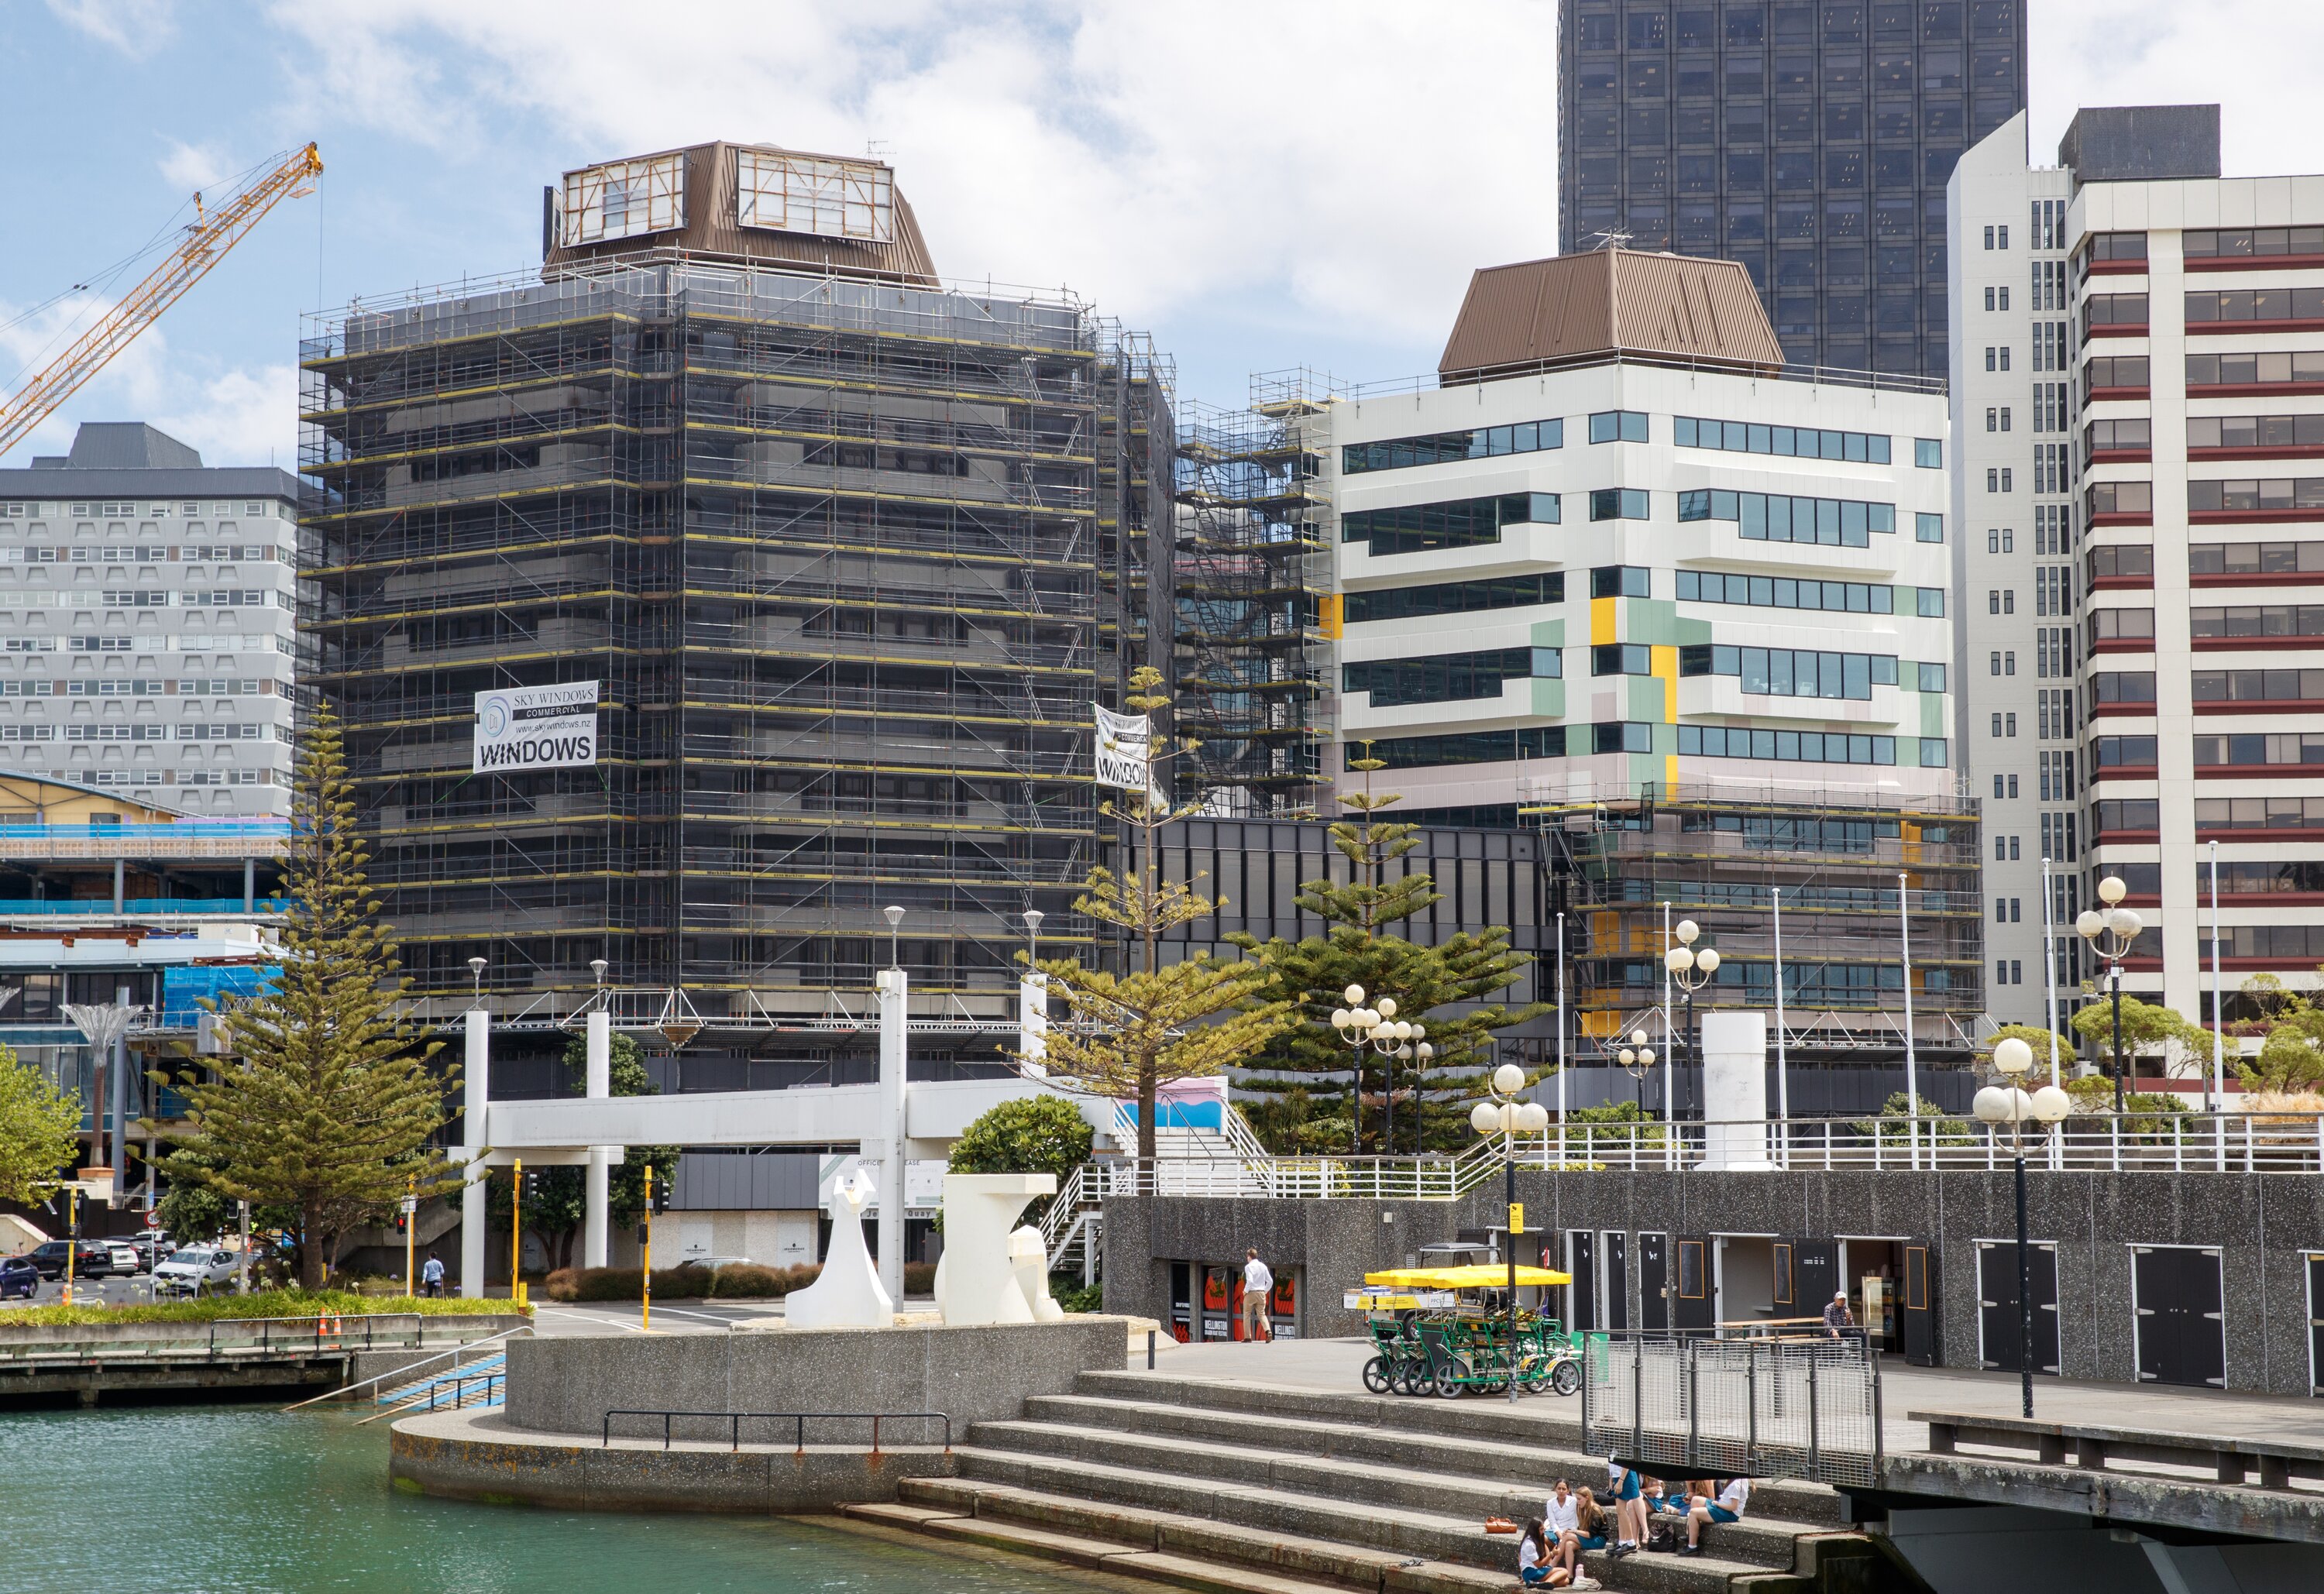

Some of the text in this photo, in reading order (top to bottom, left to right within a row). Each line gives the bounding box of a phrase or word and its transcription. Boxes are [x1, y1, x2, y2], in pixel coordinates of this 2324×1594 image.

[514, 689, 594, 706] SKY WINDOWS
[526, 706, 580, 718] COMMERCIAL
[480, 737, 591, 767] WINDOWS
[908, 1210, 930, 1218] Quay
